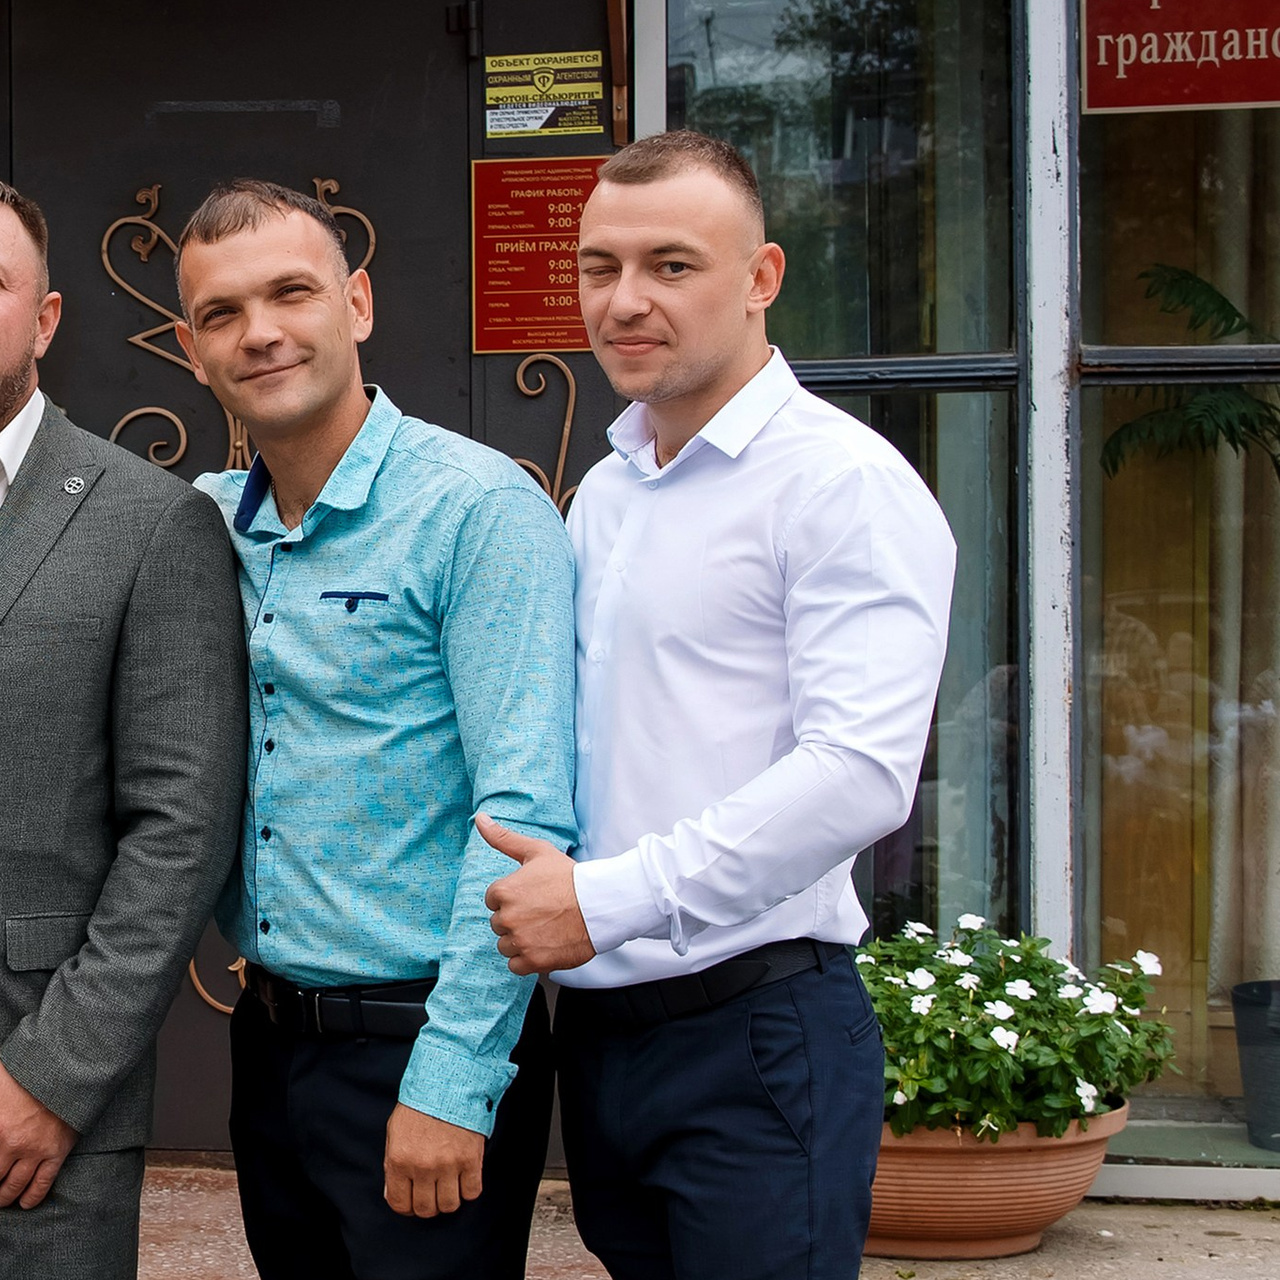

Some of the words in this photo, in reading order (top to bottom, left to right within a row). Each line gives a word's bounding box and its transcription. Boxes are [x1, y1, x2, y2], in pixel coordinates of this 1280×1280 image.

[490, 57, 531, 68] ОБЪЕКТ
[533, 54, 599, 66] ОХРАНЯЕТСЯ
[488, 74, 532, 84] ОХРАННЫМ
[556, 71, 599, 81] АГЕНТСТВОМ
[510, 189, 544, 198] ГРАФИК
[546, 188, 583, 197] РАБОТЫ:
[548, 203, 584, 213] 9:00-1
[495, 240, 536, 252] ПРИЁМ
[539, 241, 580, 252] ГРАЖД
[543, 295, 580, 307] 13:00-
